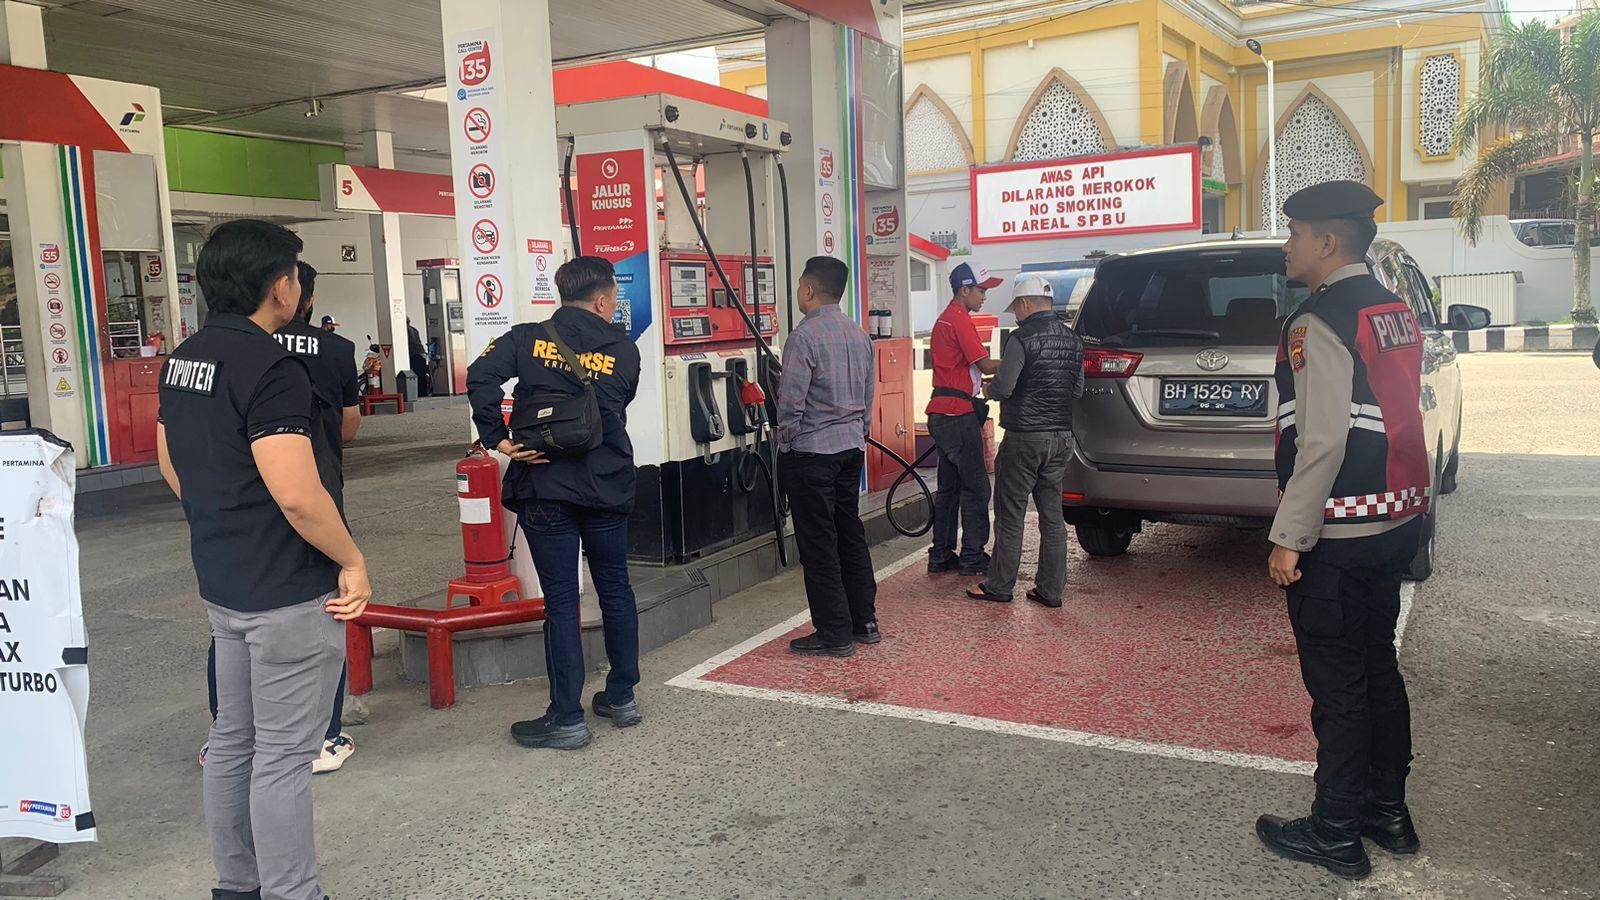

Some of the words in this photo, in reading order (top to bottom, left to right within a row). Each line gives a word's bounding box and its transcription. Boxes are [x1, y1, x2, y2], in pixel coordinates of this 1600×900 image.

[460, 58, 487, 81] 135
[762, 122, 768, 141] B
[1040, 169, 1073, 185] AWAS
[1082, 165, 1105, 181] API
[342, 180, 352, 195] 5
[592, 184, 632, 200] JALUR
[1002, 184, 1075, 203] DILARANG
[1082, 176, 1156, 197] MEROKOK
[592, 197, 633, 210] KHUSUS
[1029, 203, 1049, 215] NO
[1056, 197, 1123, 214] SMOKING
[593, 224, 633, 232] PERTAMAX
[873, 217, 896, 233] 135
[1002, 221, 1016, 234] DI
[1021, 217, 1070, 232] AREAL
[1077, 212, 1126, 228] SPBU
[1373, 311, 1419, 348] POLISI
[165, 358, 216, 392] TIPIDTER
[1164, 383, 1186, 399] BH
[1191, 383, 1232, 399] 1526
[1240, 383, 1263, 400] RY
[2, 459, 45, 467] PERTAMINA
